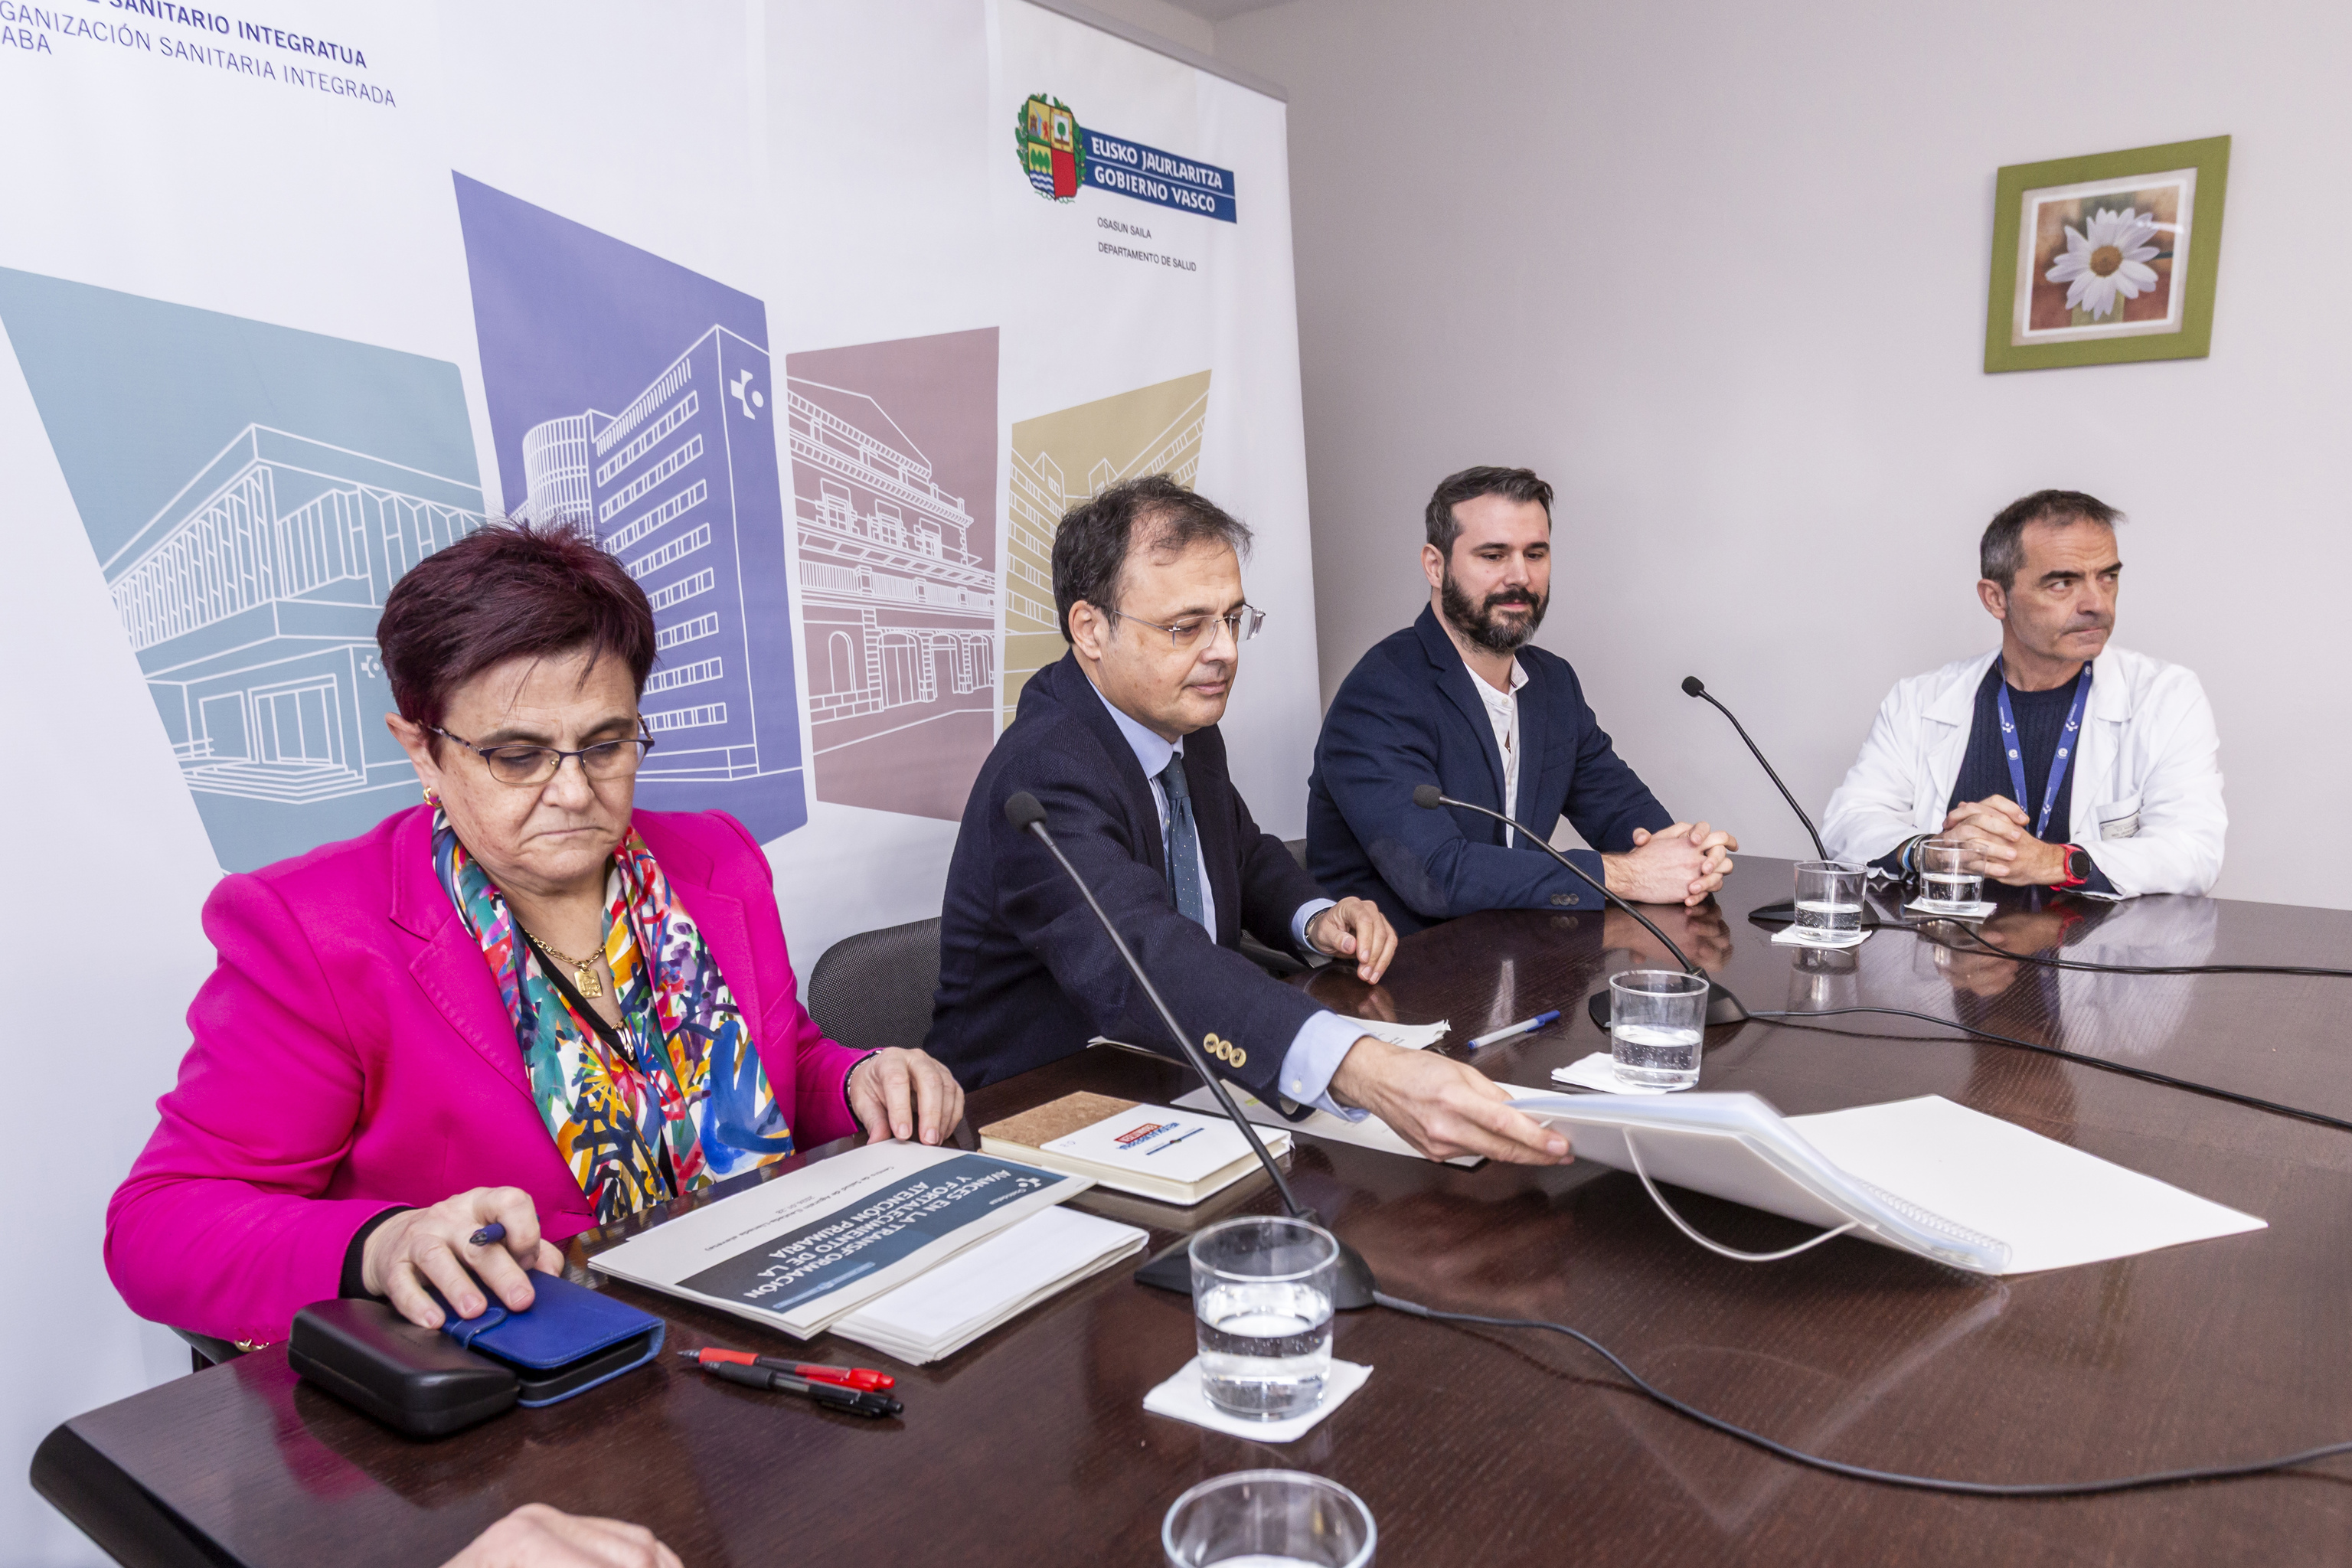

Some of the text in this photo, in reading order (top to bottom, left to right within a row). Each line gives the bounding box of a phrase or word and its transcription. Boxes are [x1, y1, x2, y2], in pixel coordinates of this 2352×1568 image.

[0, 1, 397, 108] GANIZACIÓN SANITARIA INTEGRADA
[2, 25, 53, 55] ABA
[238, 20, 368, 70] INTEGRATUA
[1091, 136, 1223, 189] EUSKO JAURLARITZA
[1094, 166, 1215, 213] GOBIERNO VASCO
[1097, 217, 1152, 239] OSASUN SAILA
[1098, 241, 1197, 272] DEPARTAMENTO DE SALUD
[922, 1198, 951, 1212] EN
[946, 1169, 1012, 1200] AVANCES
[756, 1175, 972, 1278] Y FORTALECIMIENTO DE LA
[768, 1181, 929, 1259] ATENCIÓN PRIMARIA
[898, 1211, 928, 1223] LA
[743, 1223, 906, 1299] TRANSFORMACIÓN
